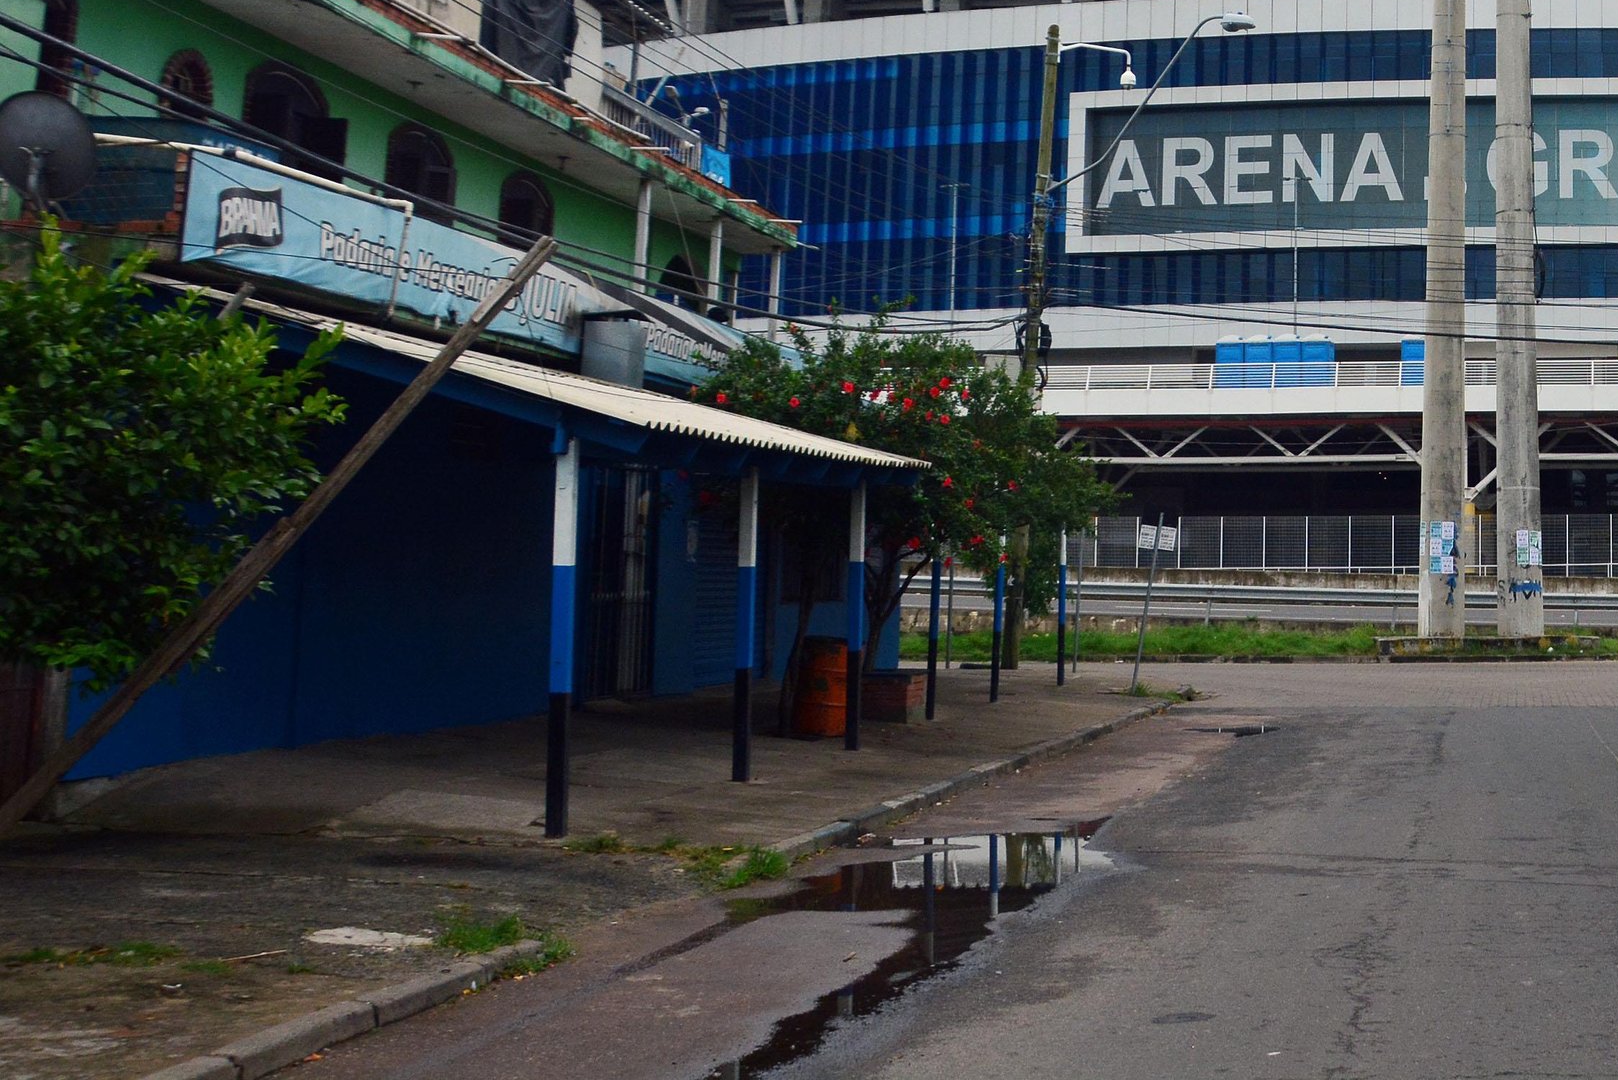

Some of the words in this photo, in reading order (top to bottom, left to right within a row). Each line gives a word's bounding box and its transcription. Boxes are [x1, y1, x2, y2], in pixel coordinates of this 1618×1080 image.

[1096, 132, 1404, 208] ARENA
[320, 220, 396, 278] Padaria
[398, 251, 412, 282] e
